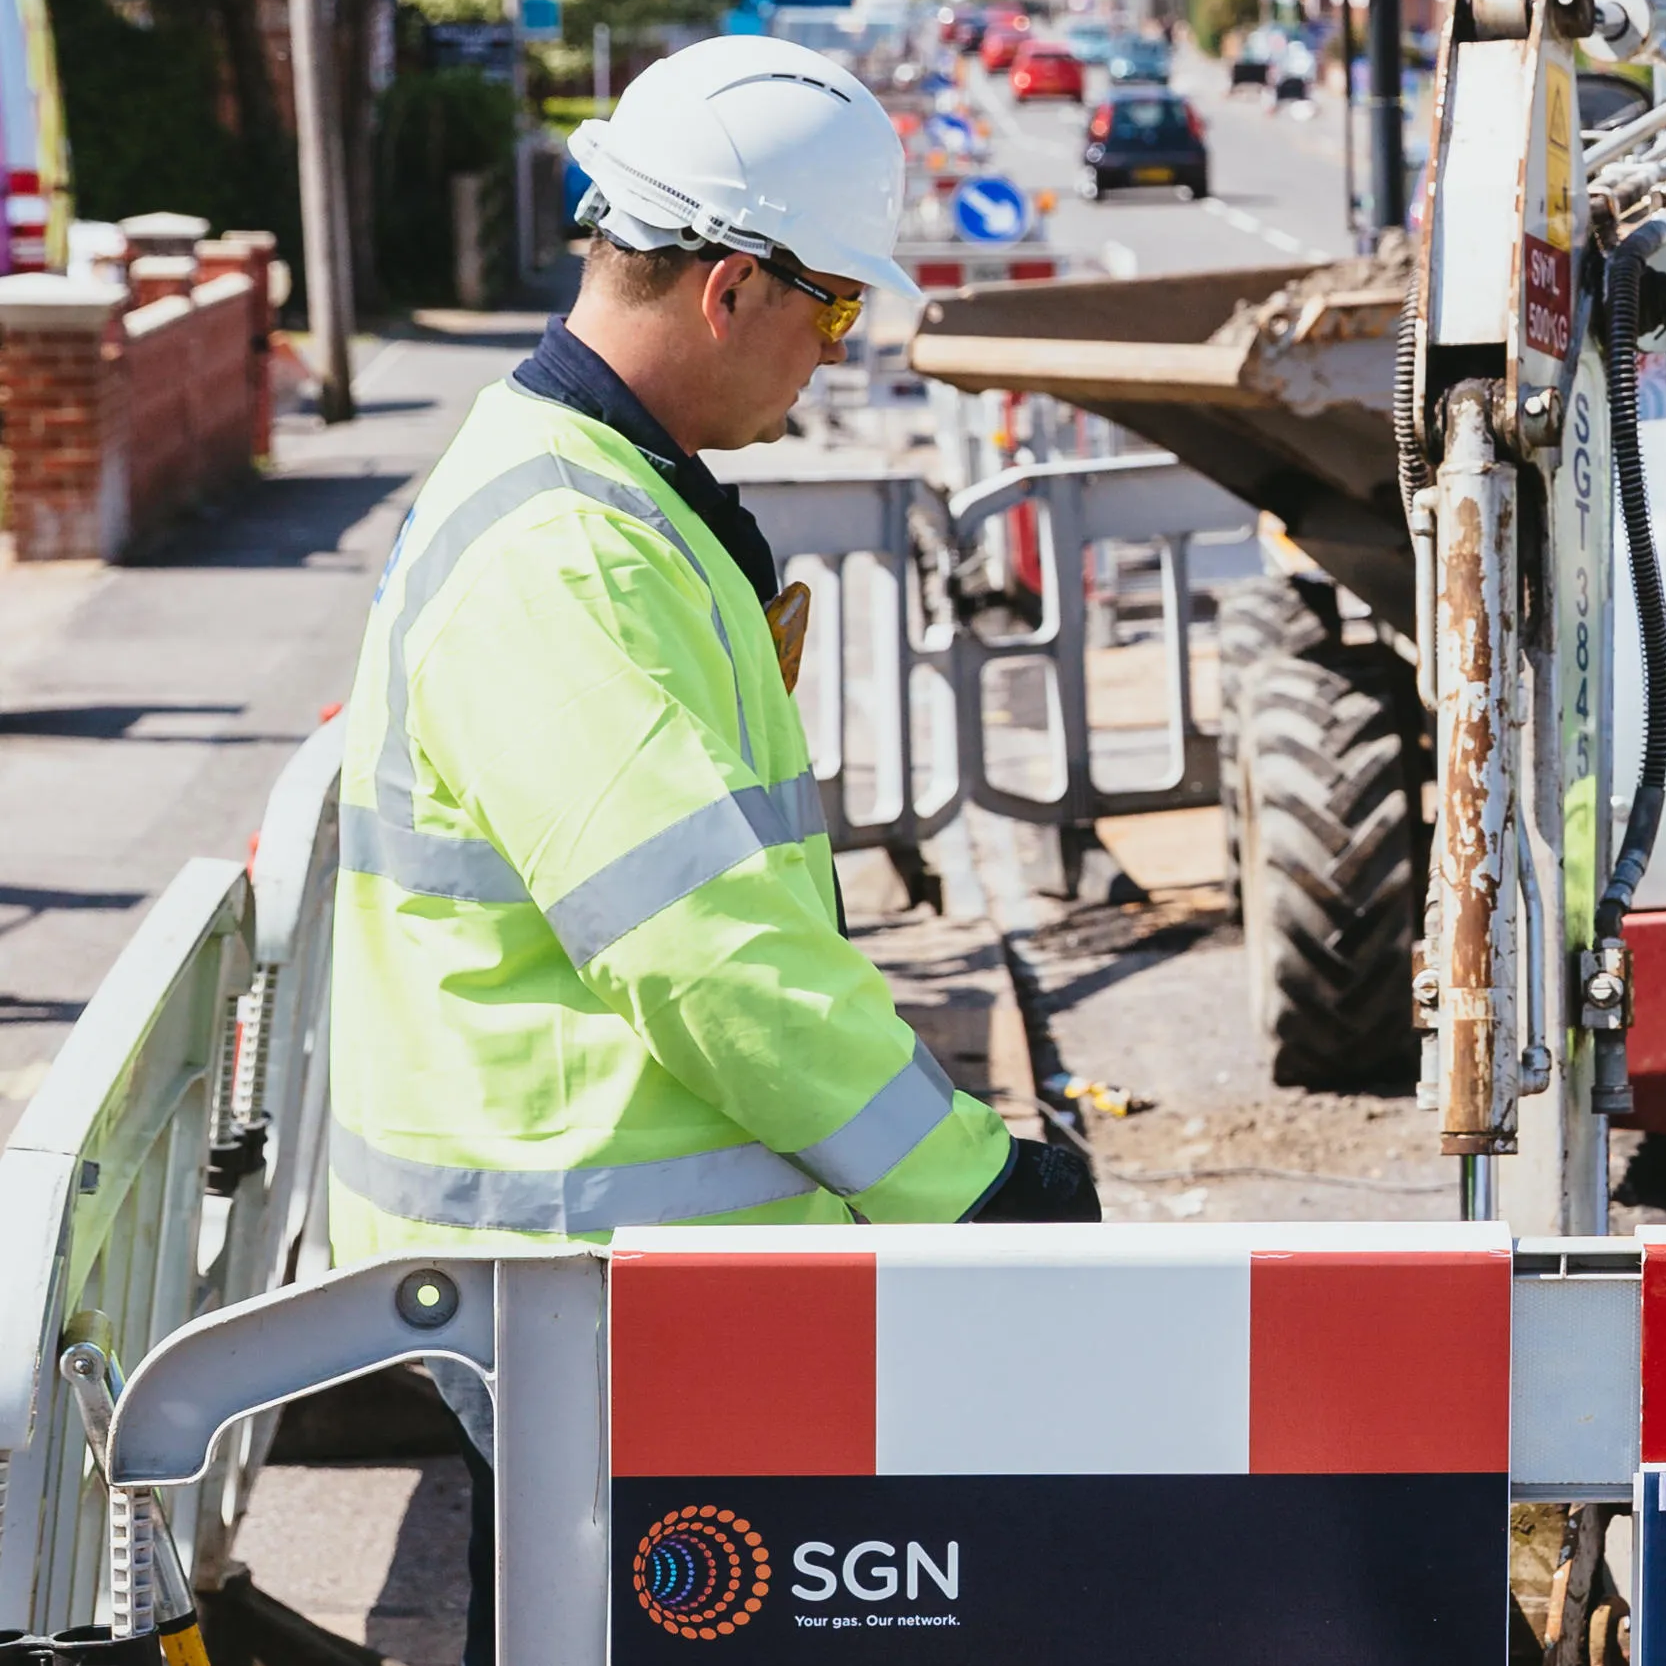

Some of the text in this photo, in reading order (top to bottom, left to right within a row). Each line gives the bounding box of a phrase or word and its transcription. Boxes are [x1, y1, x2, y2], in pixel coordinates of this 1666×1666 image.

[1528, 300, 1569, 352] 500KG
[791, 1540, 959, 1602] SGN
[794, 1614, 961, 1629] Your gas. Our network.
